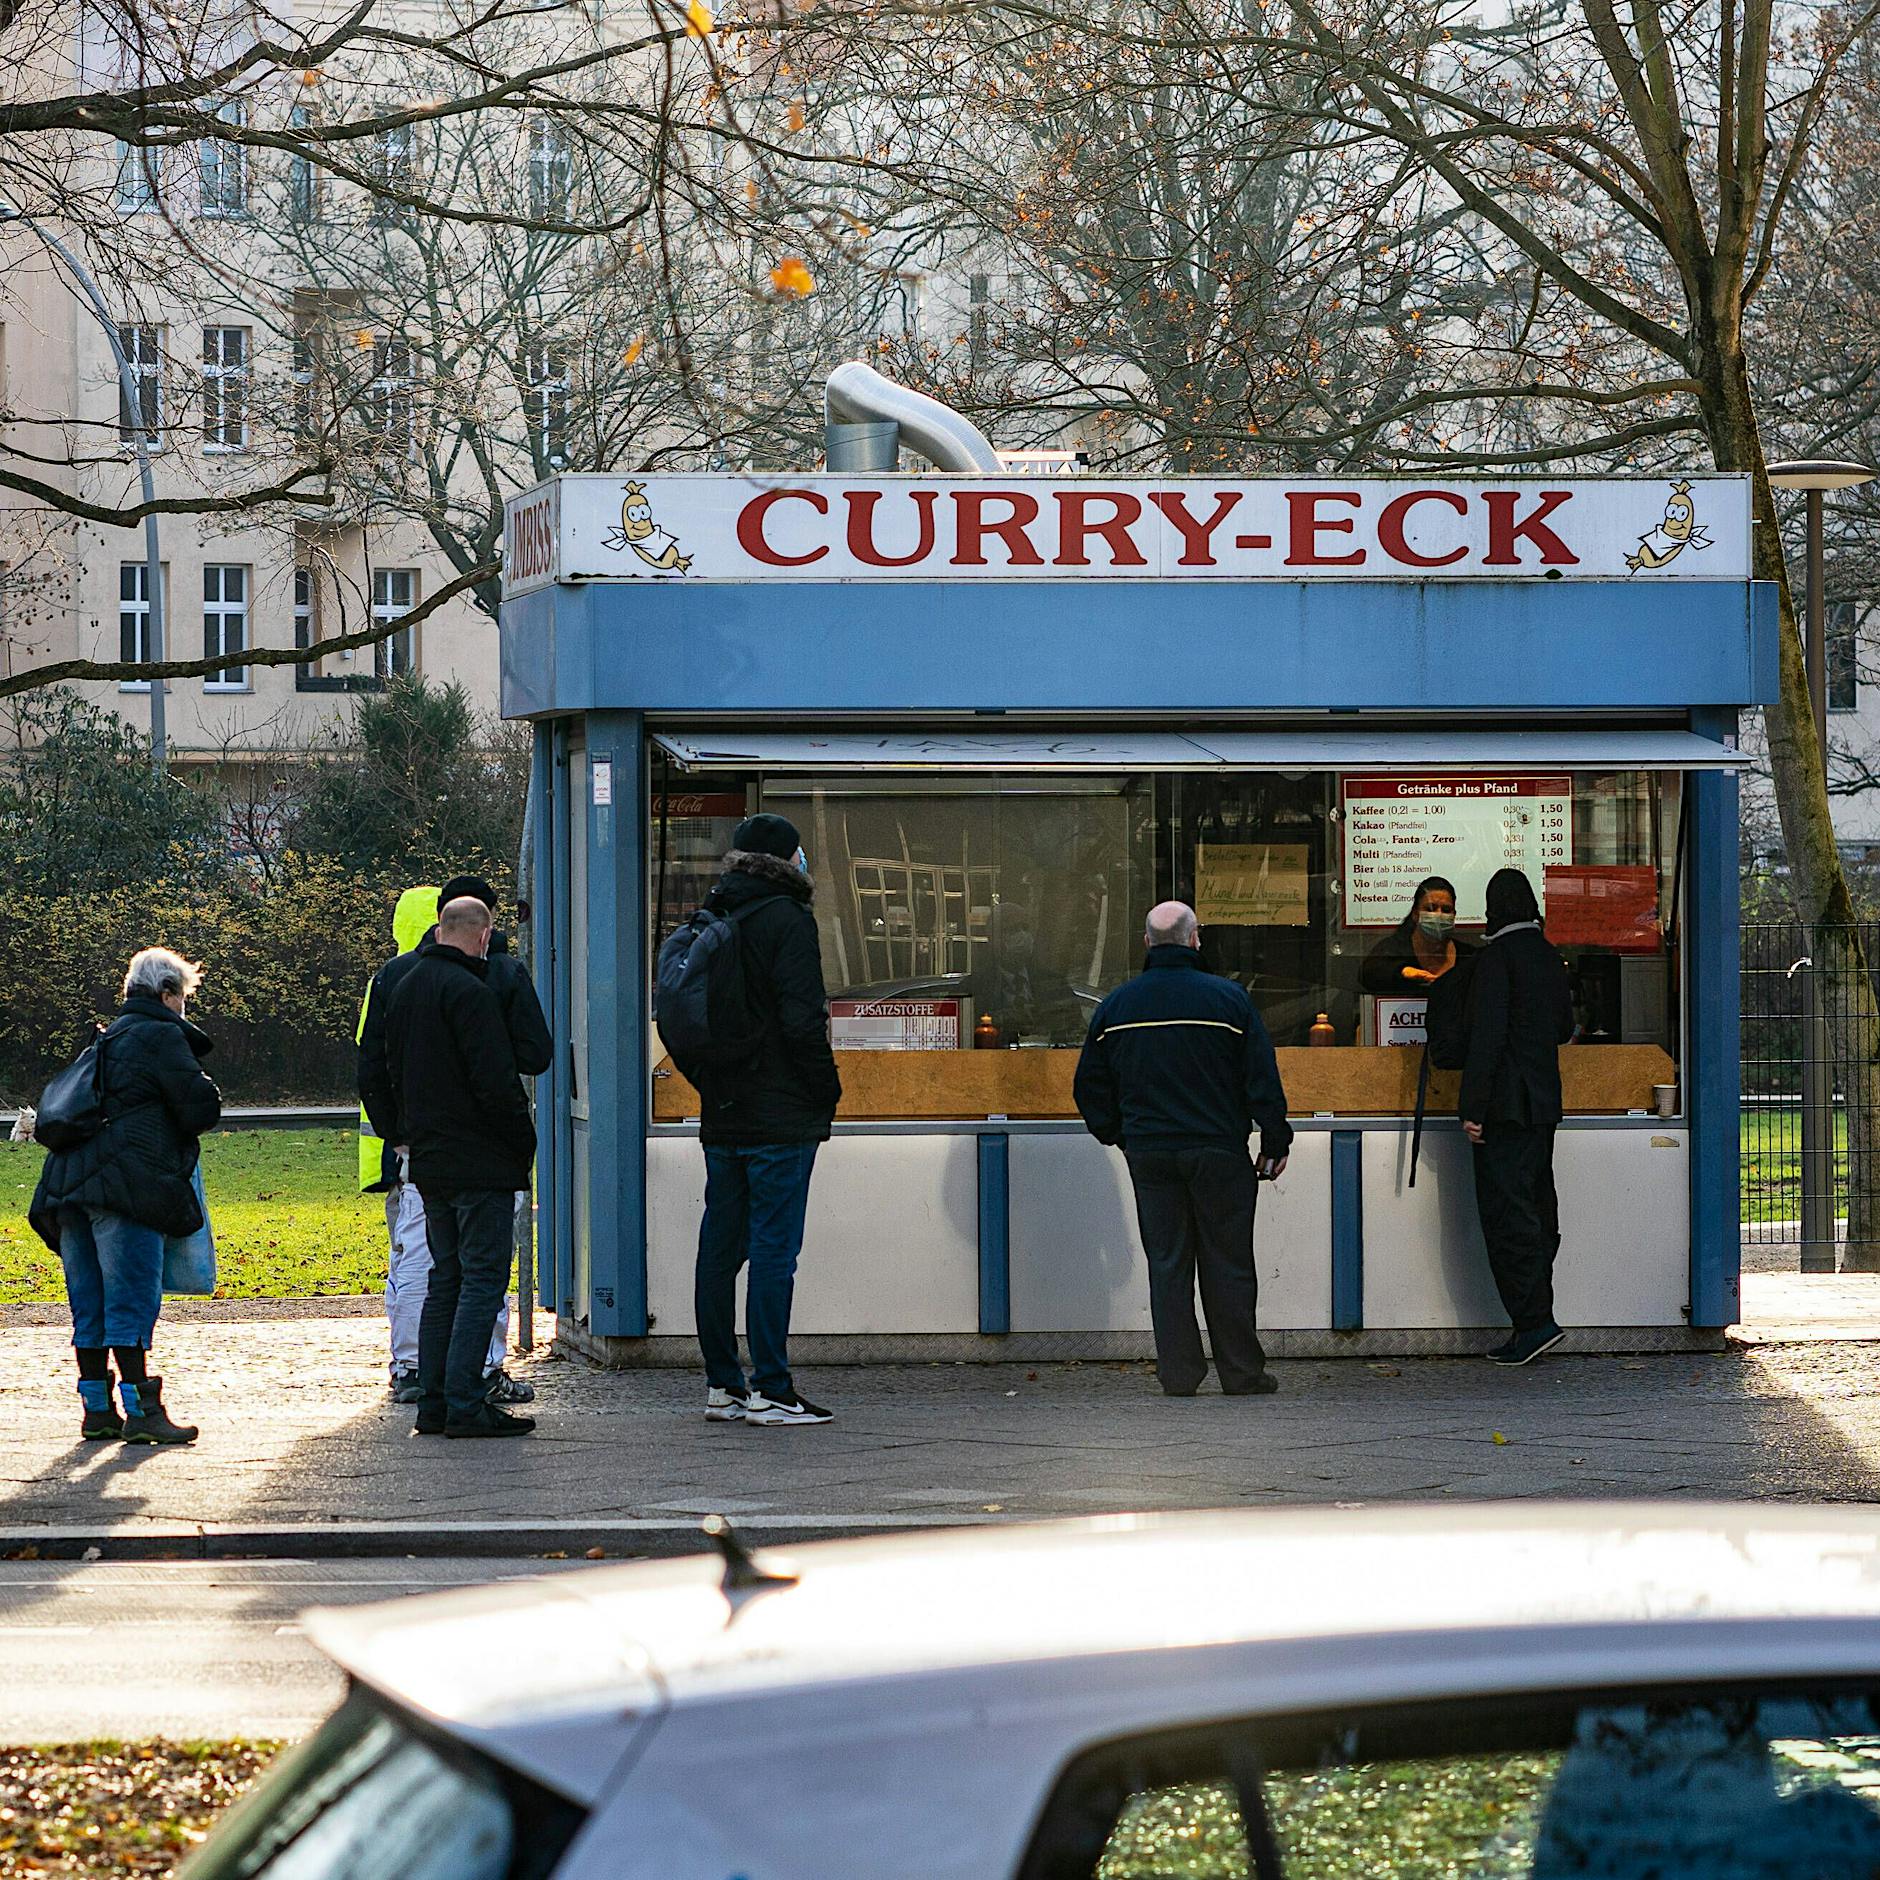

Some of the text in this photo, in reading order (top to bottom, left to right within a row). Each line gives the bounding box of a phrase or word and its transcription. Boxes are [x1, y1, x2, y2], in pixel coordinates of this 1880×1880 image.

[736, 488, 1580, 568] CURRY-ECK
[1397, 782, 1518, 796] Getränke plus Pfand
[1352, 806, 1385, 815] Kaffee
[1540, 804, 1563, 815] 1,50
[1352, 821, 1385, 830] Kakao
[1541, 819, 1563, 830] 1,50
[1541, 833, 1563, 844] 1,50
[1353, 850, 1380, 859] Multi
[1383, 850, 1422, 860] (Pfandfrei)
[1541, 848, 1563, 858] 1,50
[1353, 865, 1374, 874] Bier
[1392, 865, 1402, 873] 18
[1353, 880, 1370, 888] Vio
[1353, 894, 1388, 903] Nestea
[854, 1003, 935, 1016] ZUSATZSTOFFE
